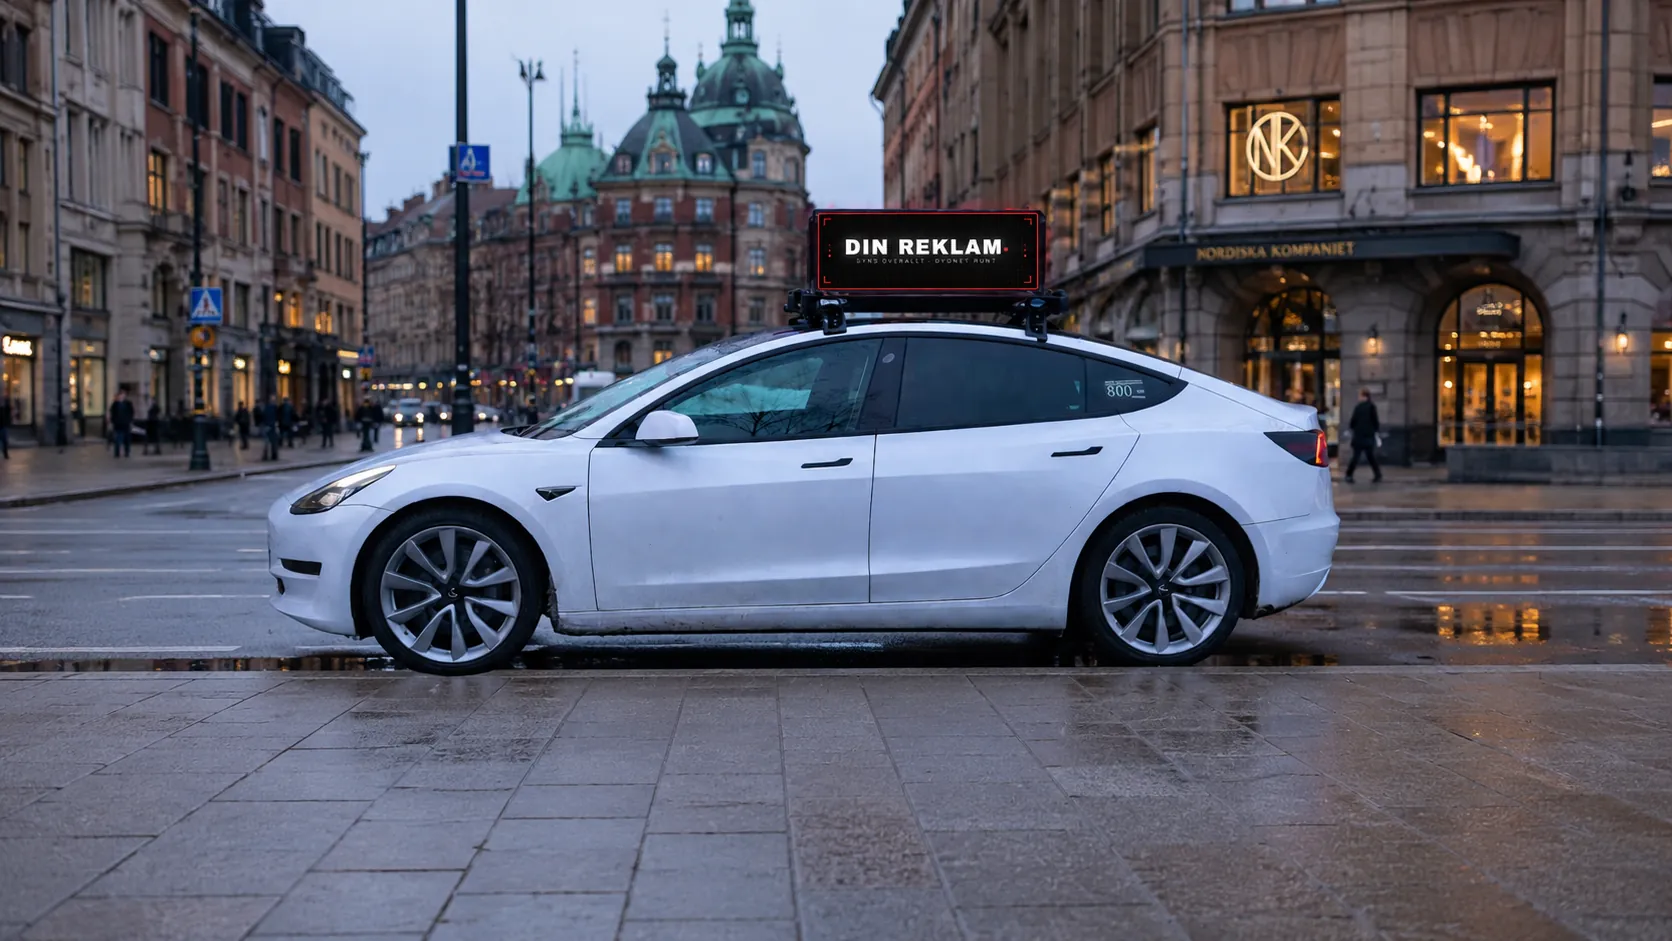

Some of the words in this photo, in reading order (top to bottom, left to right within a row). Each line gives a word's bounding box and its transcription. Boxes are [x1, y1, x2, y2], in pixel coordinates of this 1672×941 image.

[1246, 111, 1308, 181] NK
[845, 239, 888, 255] DIN
[1197, 246, 1267, 261] NORDISKA
[1271, 241, 1355, 258] KOMPANIET
[1107, 385, 1132, 397] 800
